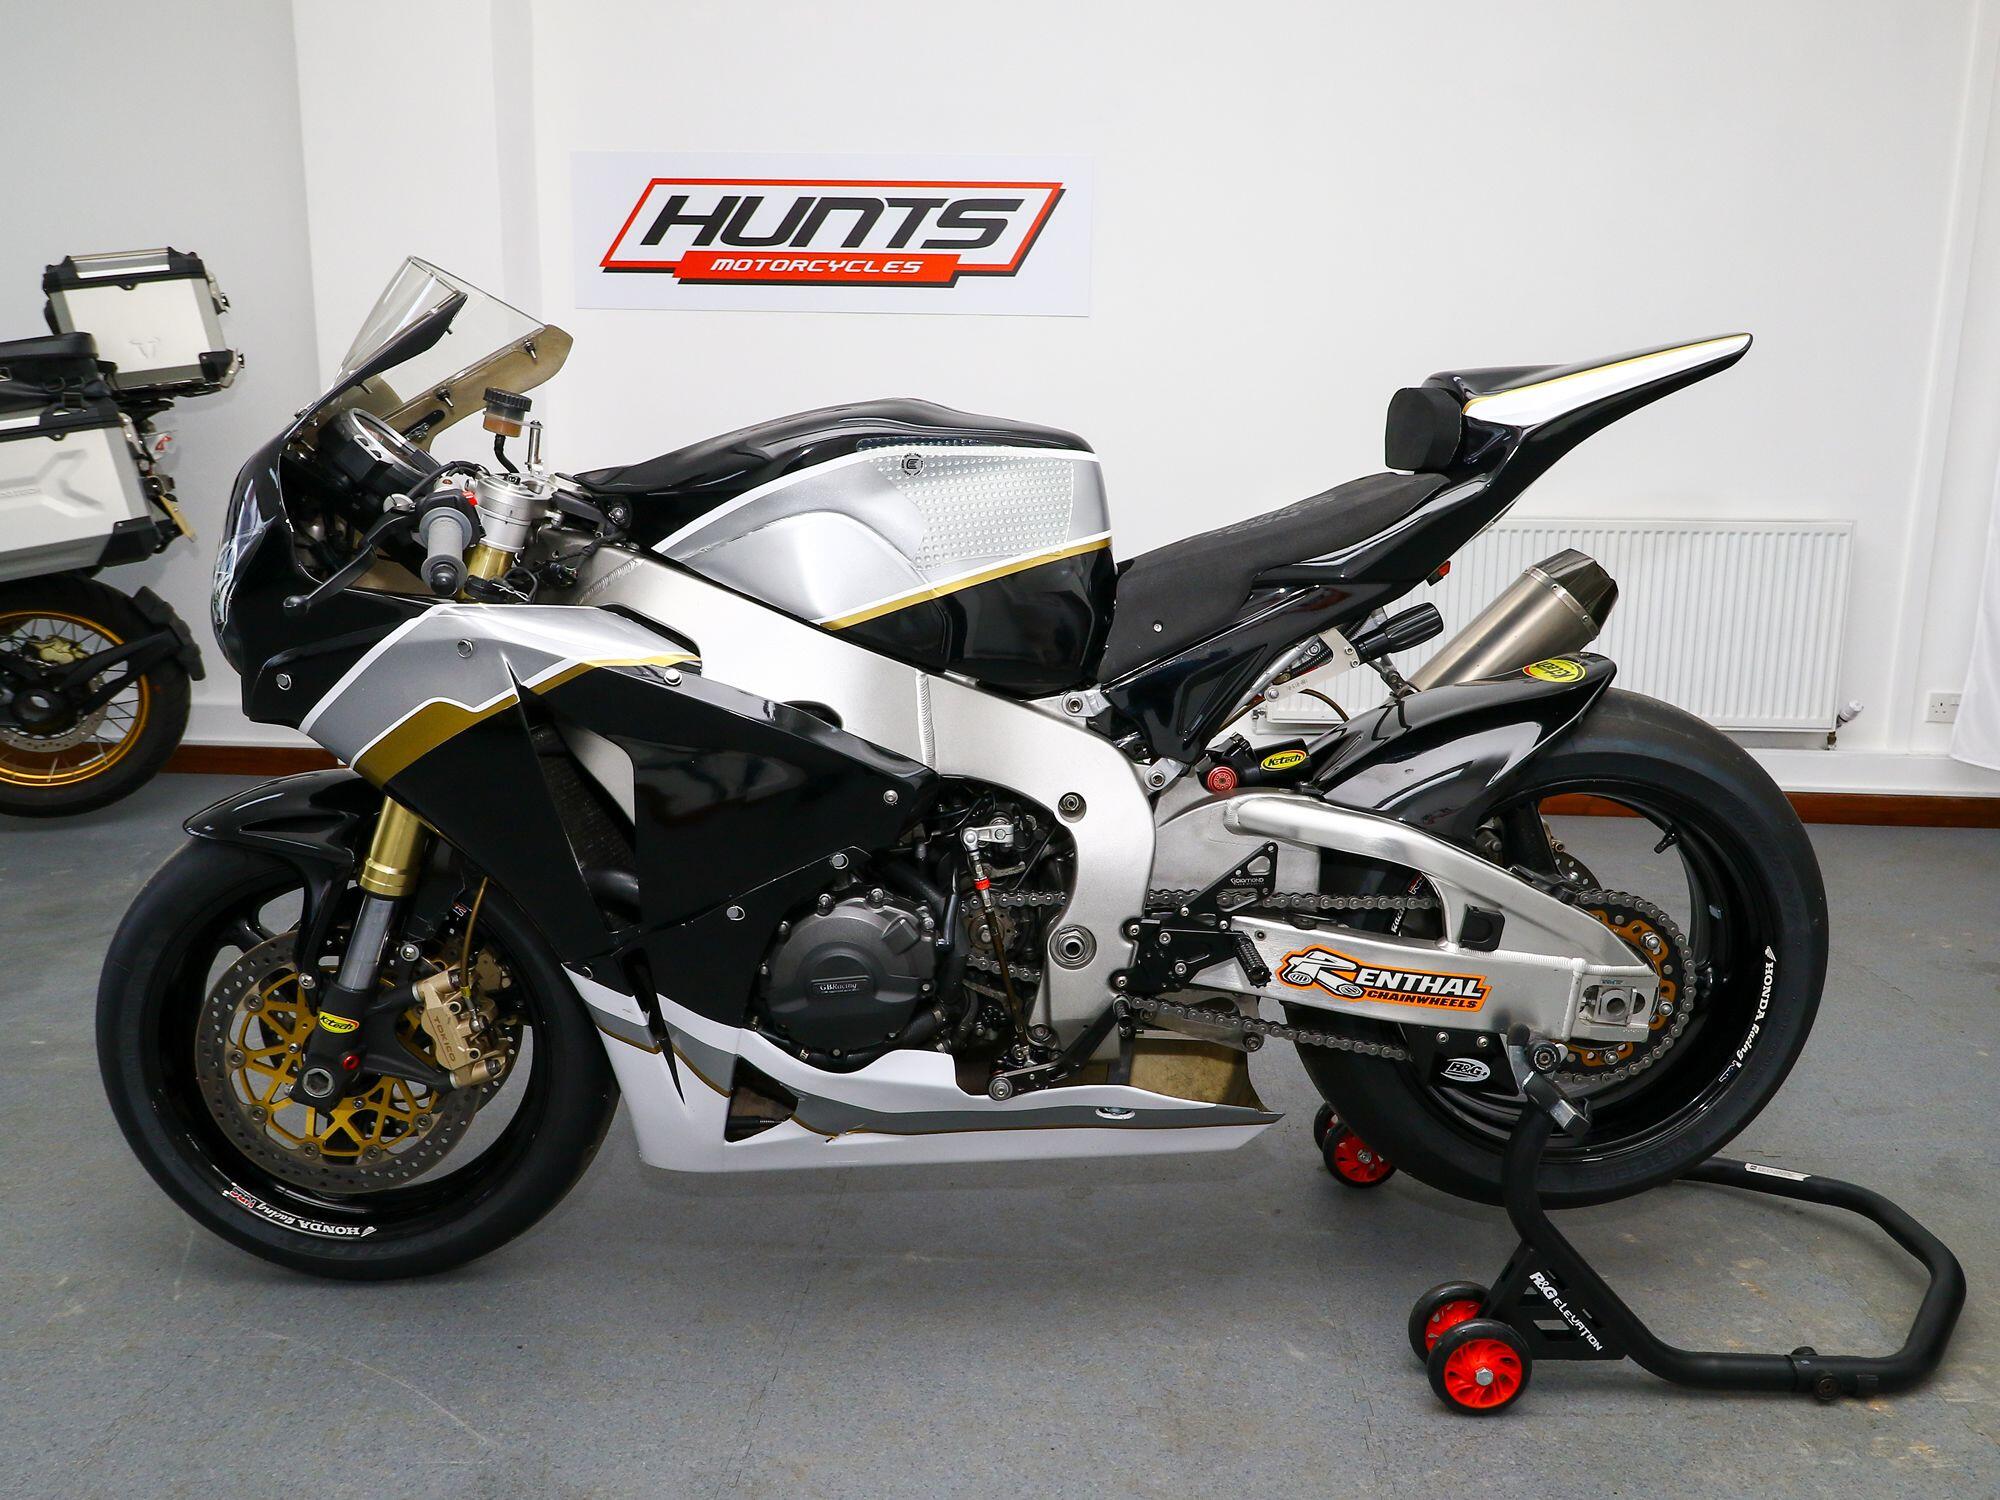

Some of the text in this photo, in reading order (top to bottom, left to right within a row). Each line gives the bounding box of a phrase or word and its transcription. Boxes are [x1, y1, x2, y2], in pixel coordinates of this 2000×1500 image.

[640, 195, 1025, 248] HUNTS
[710, 258, 924, 274] MOTORCYCLES
[1282, 950, 1483, 998] RENTHAL
[1366, 990, 1478, 1009] CHAINWHEELS
[1736, 961, 1774, 1061] HONDA Racing
[433, 1016, 456, 1062] TOKICO
[255, 1201, 296, 1225] Racing
[299, 1218, 361, 1236] HONDA
[1529, 1271, 1558, 1300] R&G
